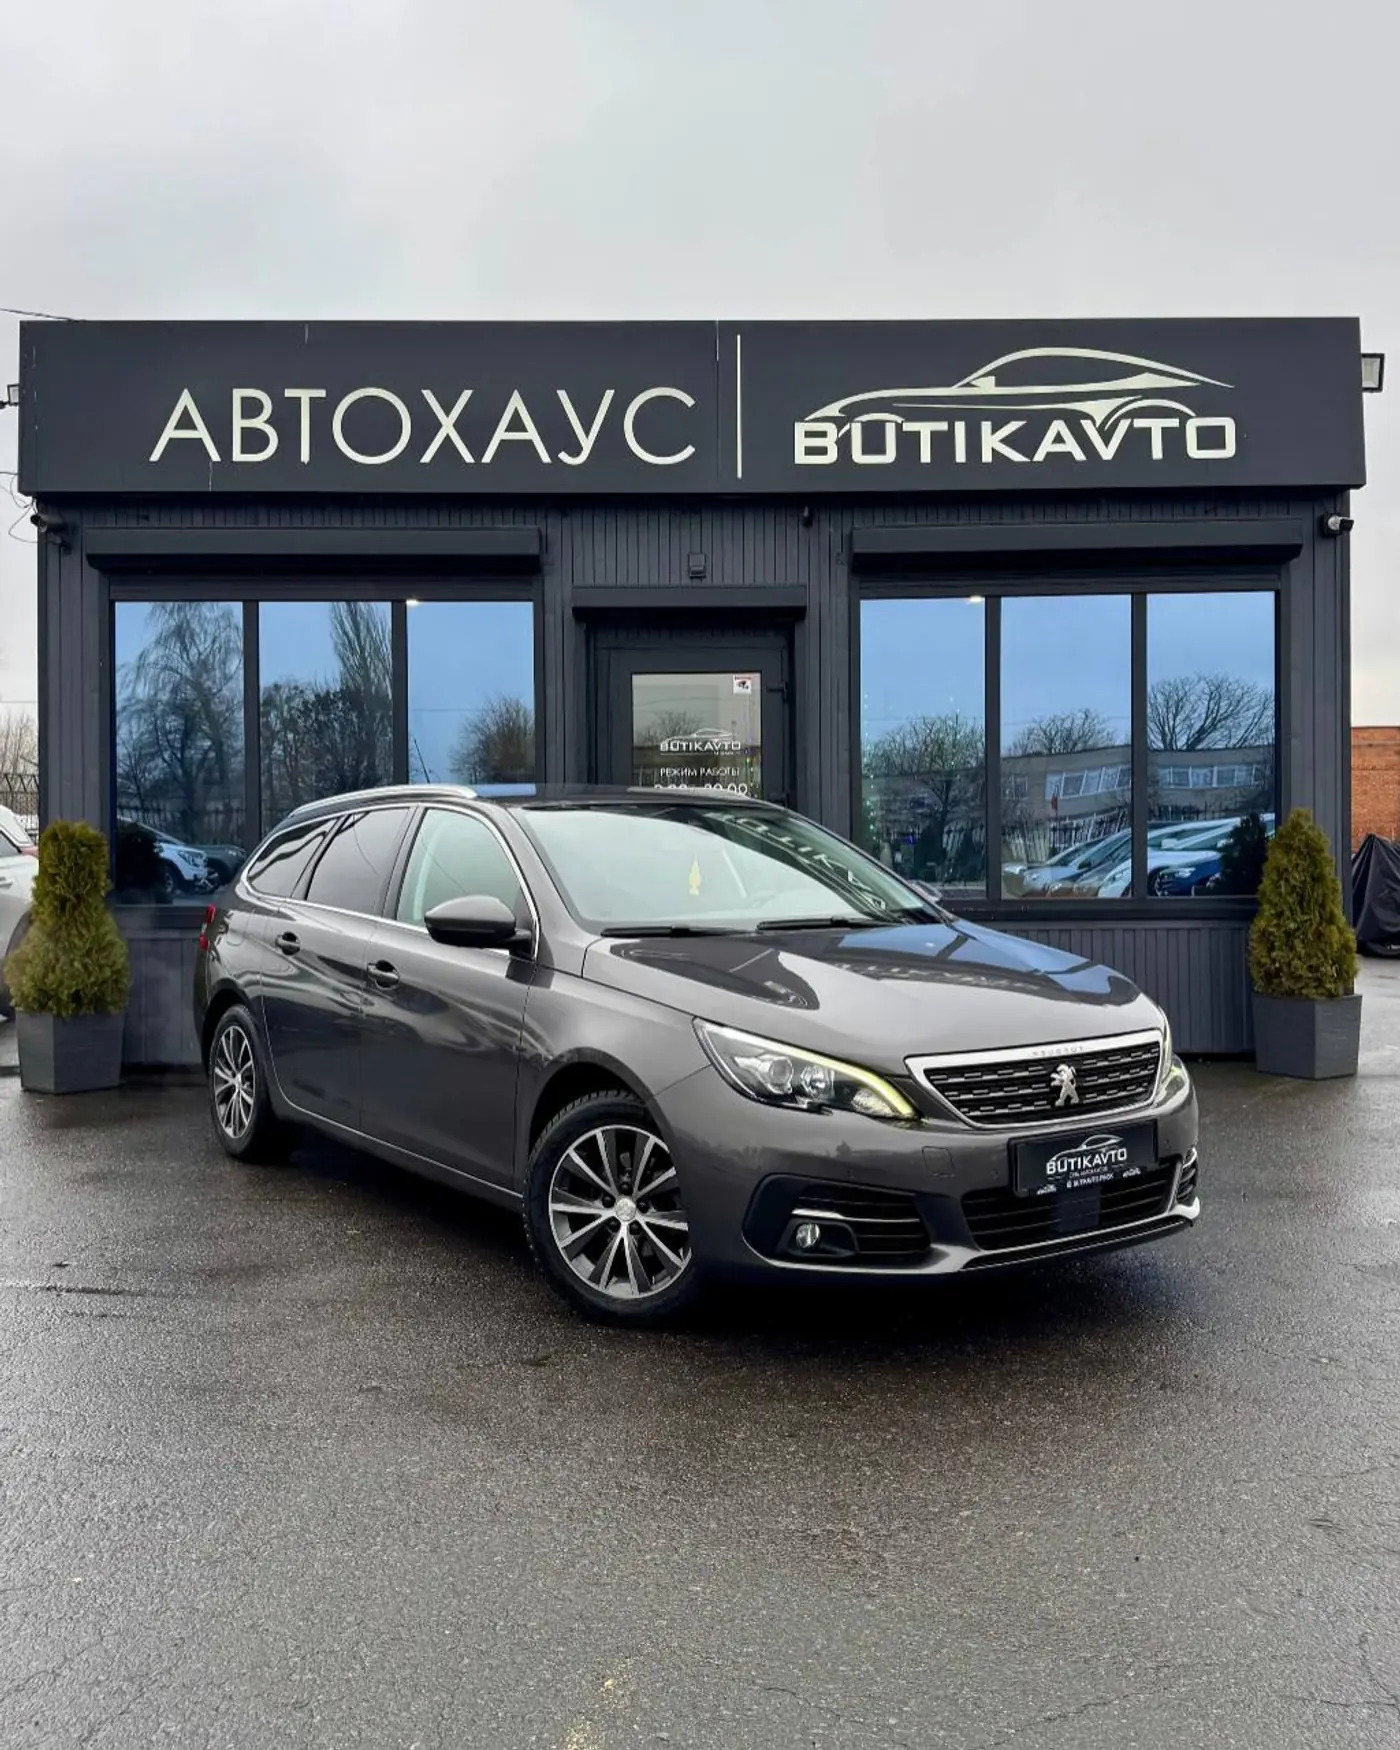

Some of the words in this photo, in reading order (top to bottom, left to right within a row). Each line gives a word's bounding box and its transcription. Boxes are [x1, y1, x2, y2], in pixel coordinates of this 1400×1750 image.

[149, 387, 697, 465] АВТОХАУС
[794, 416, 1237, 465] BUTIKAVTO
[660, 740, 741, 752] BUTIKAVTO
[660, 767, 697, 777] РЕЖИМ
[700, 767, 740, 777] РАБОТЫ
[1046, 1147, 1127, 1175] BUTIKAVTO
